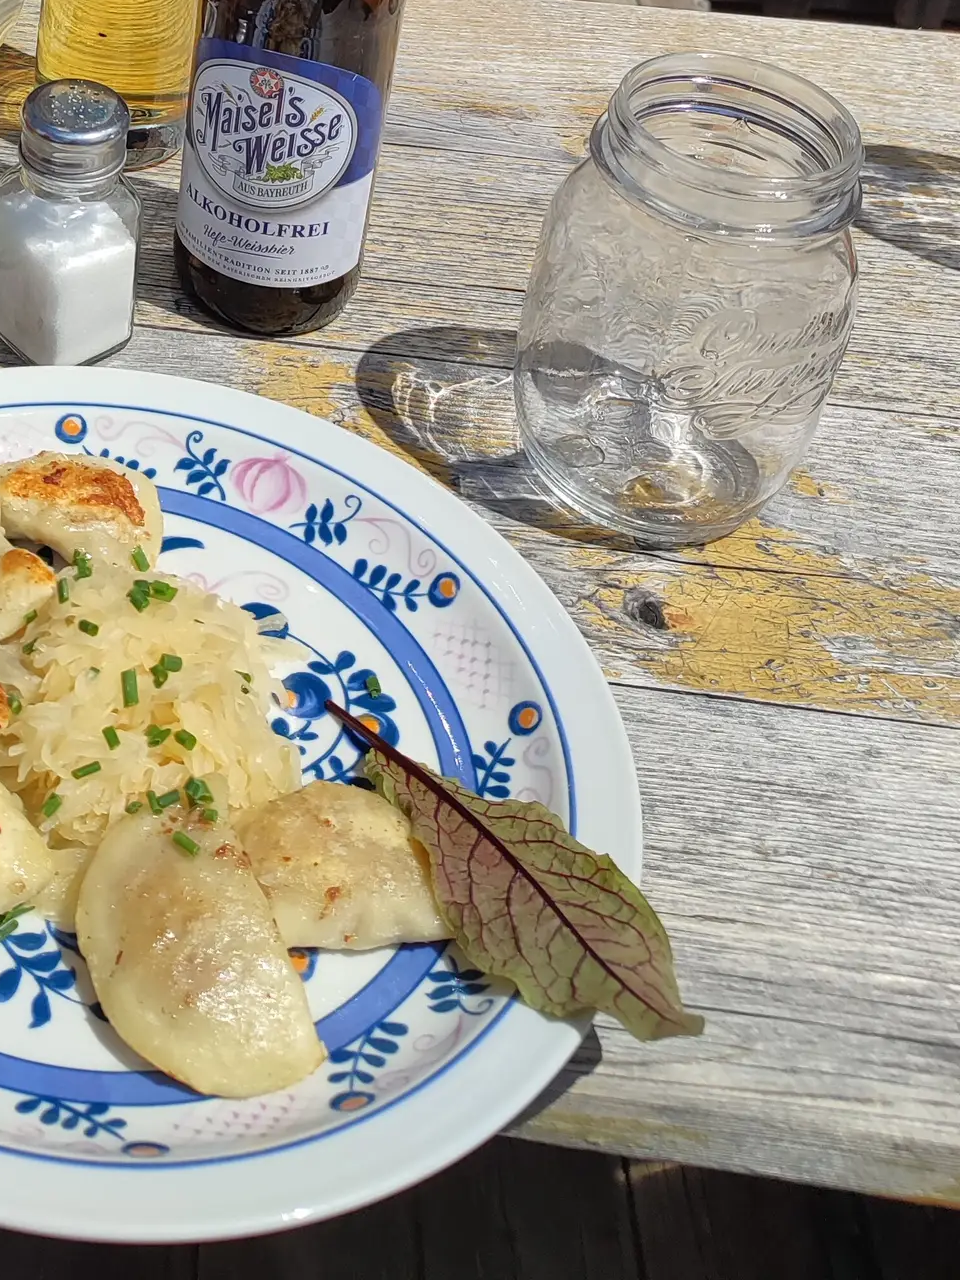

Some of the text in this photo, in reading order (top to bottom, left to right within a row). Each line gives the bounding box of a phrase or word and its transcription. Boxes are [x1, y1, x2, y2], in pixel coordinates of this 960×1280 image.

[196, 85, 306, 153] Maisel's
[233, 113, 343, 175] Weisse
[186, 182, 331, 239] ALKOHOLFREI
[238, 180, 309, 197] AUS BAYREUTH
[185, 228, 271, 274] FAMILIENTRADITION
[300, 266, 319, 275] 1887
[203, 223, 296, 256] Hefe-Weissbier
